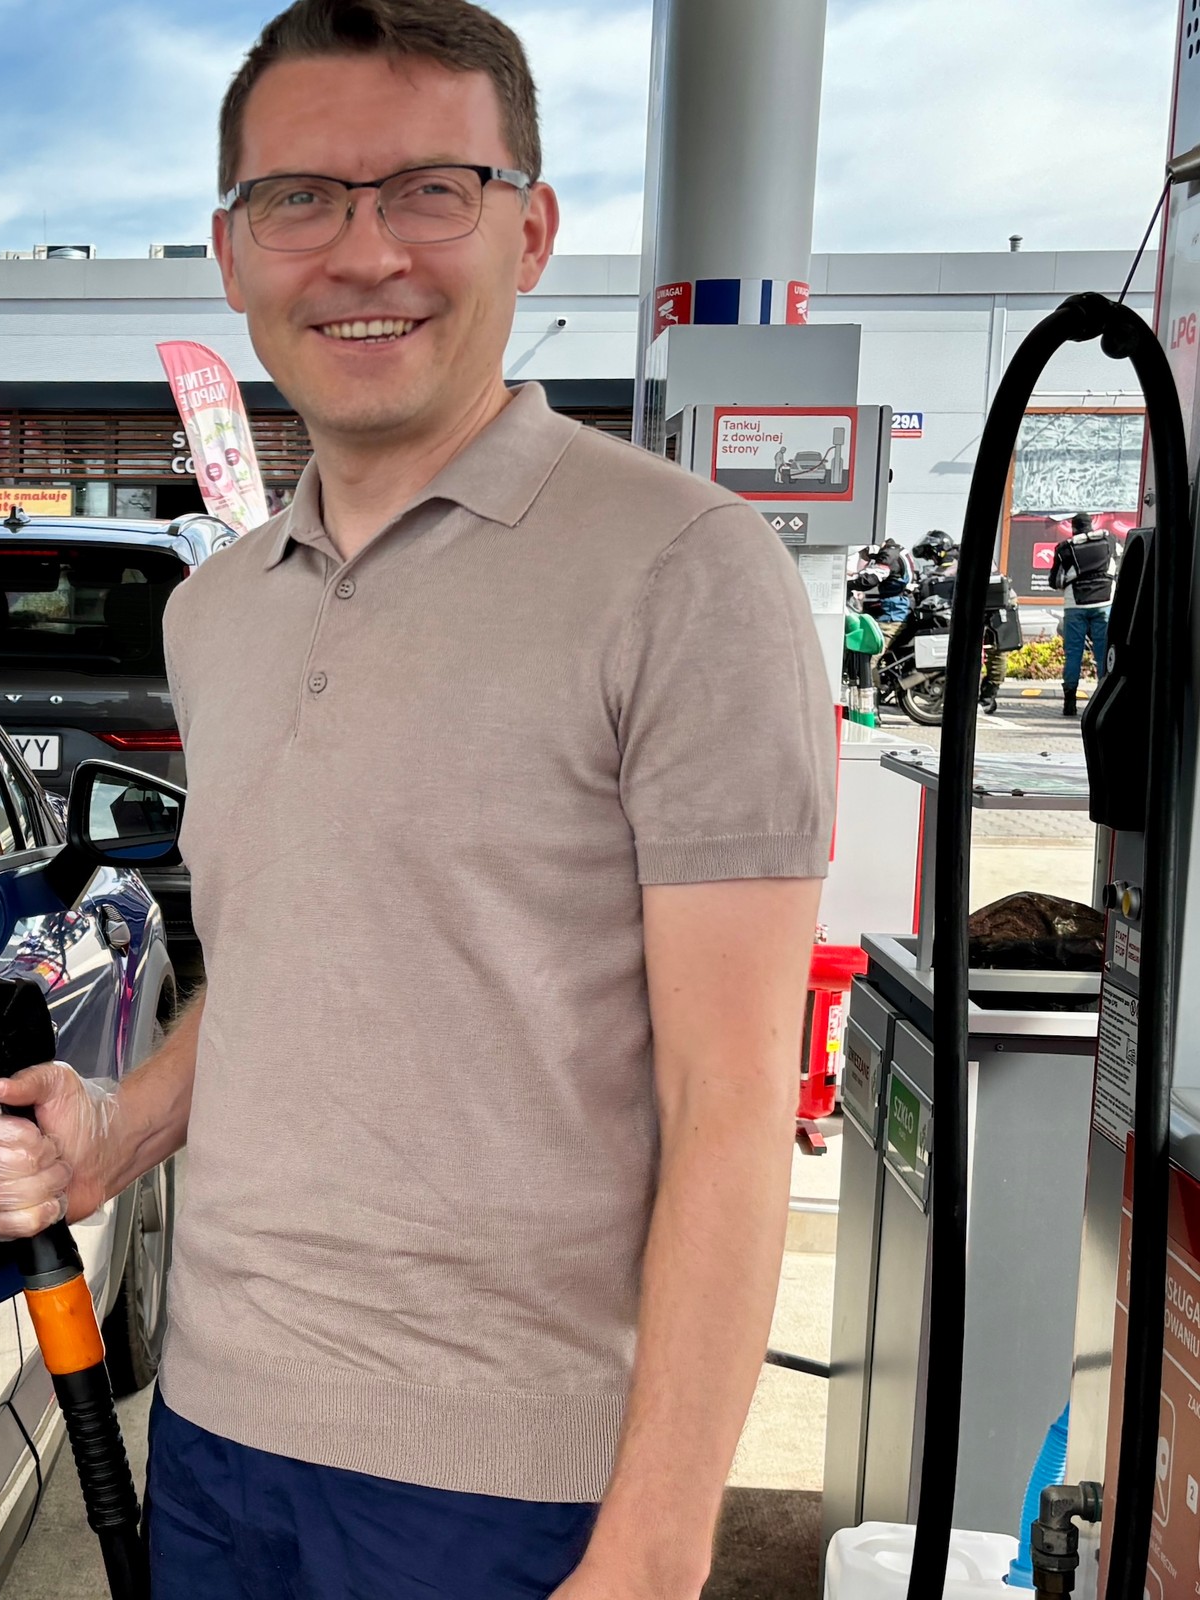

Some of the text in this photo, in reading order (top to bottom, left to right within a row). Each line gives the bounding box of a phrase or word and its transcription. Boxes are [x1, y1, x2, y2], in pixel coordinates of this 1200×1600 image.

[657, 286, 683, 299] UWAGA!
[794, 286, 809, 297] UWAG
[1171, 312, 1197, 350] LPG
[723, 420, 760, 432] Tankuj
[892, 415, 920, 430] 29A
[172, 430, 186, 449] S
[722, 432, 783, 444] z dowolnej
[722, 444, 759, 456] strony
[171, 456, 196, 474] CO
[13, 491, 68, 503] smakuje
[15, 738, 50, 768] YY
[893, 1095, 914, 1134] SZKŁO
[1165, 1274, 1200, 1329] SŁUGA
[1164, 1309, 1200, 1358] OWANIU
[1188, 1393, 1200, 1420] ZAK
[1189, 1486, 1195, 1502] 2
